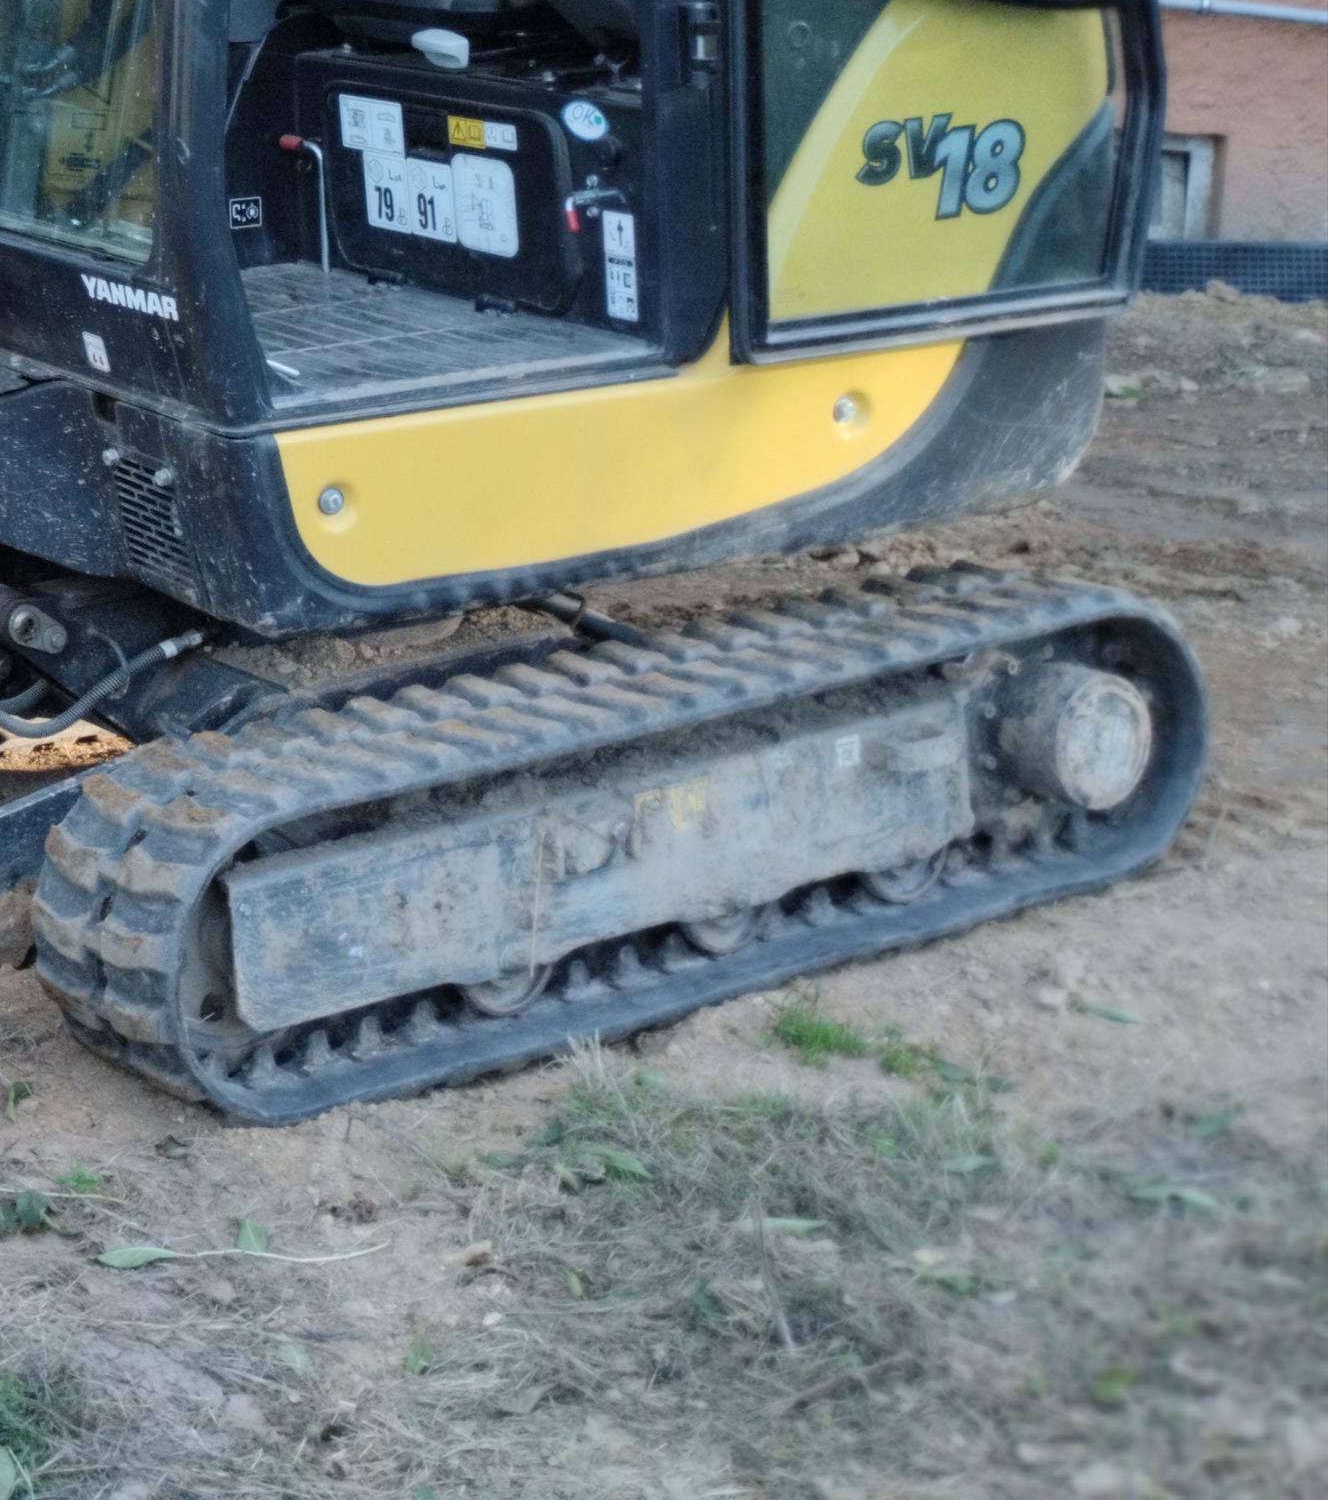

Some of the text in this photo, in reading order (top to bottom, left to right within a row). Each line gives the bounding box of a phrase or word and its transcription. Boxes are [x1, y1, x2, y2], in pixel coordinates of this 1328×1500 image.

[374, 185, 395, 222] 79
[417, 192, 437, 232] 91
[81, 274, 179, 322] YANMAR
